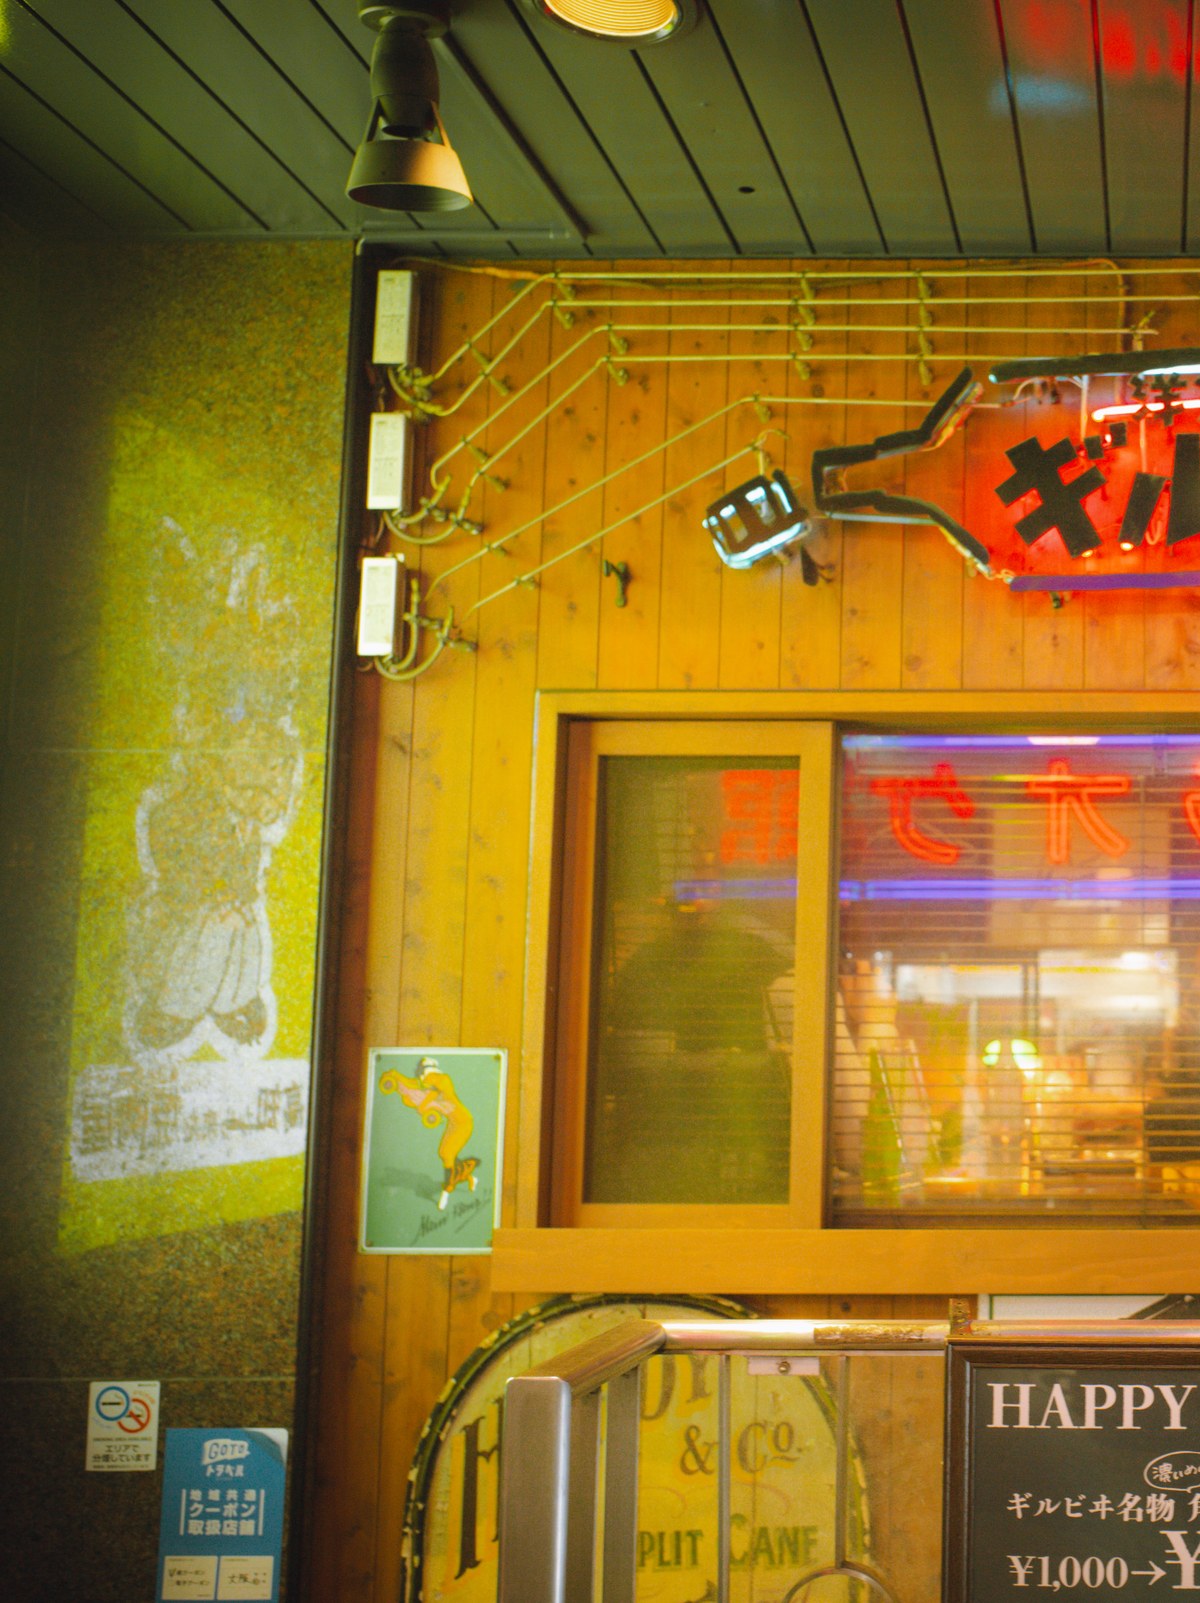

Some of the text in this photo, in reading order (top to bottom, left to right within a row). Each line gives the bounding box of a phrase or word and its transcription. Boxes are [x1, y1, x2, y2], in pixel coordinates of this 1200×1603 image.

[987, 1383, 1197, 1430] HAPPY
[680, 1424, 720, 1476] &
[1006, 1555, 1128, 1591] ¥1,000
